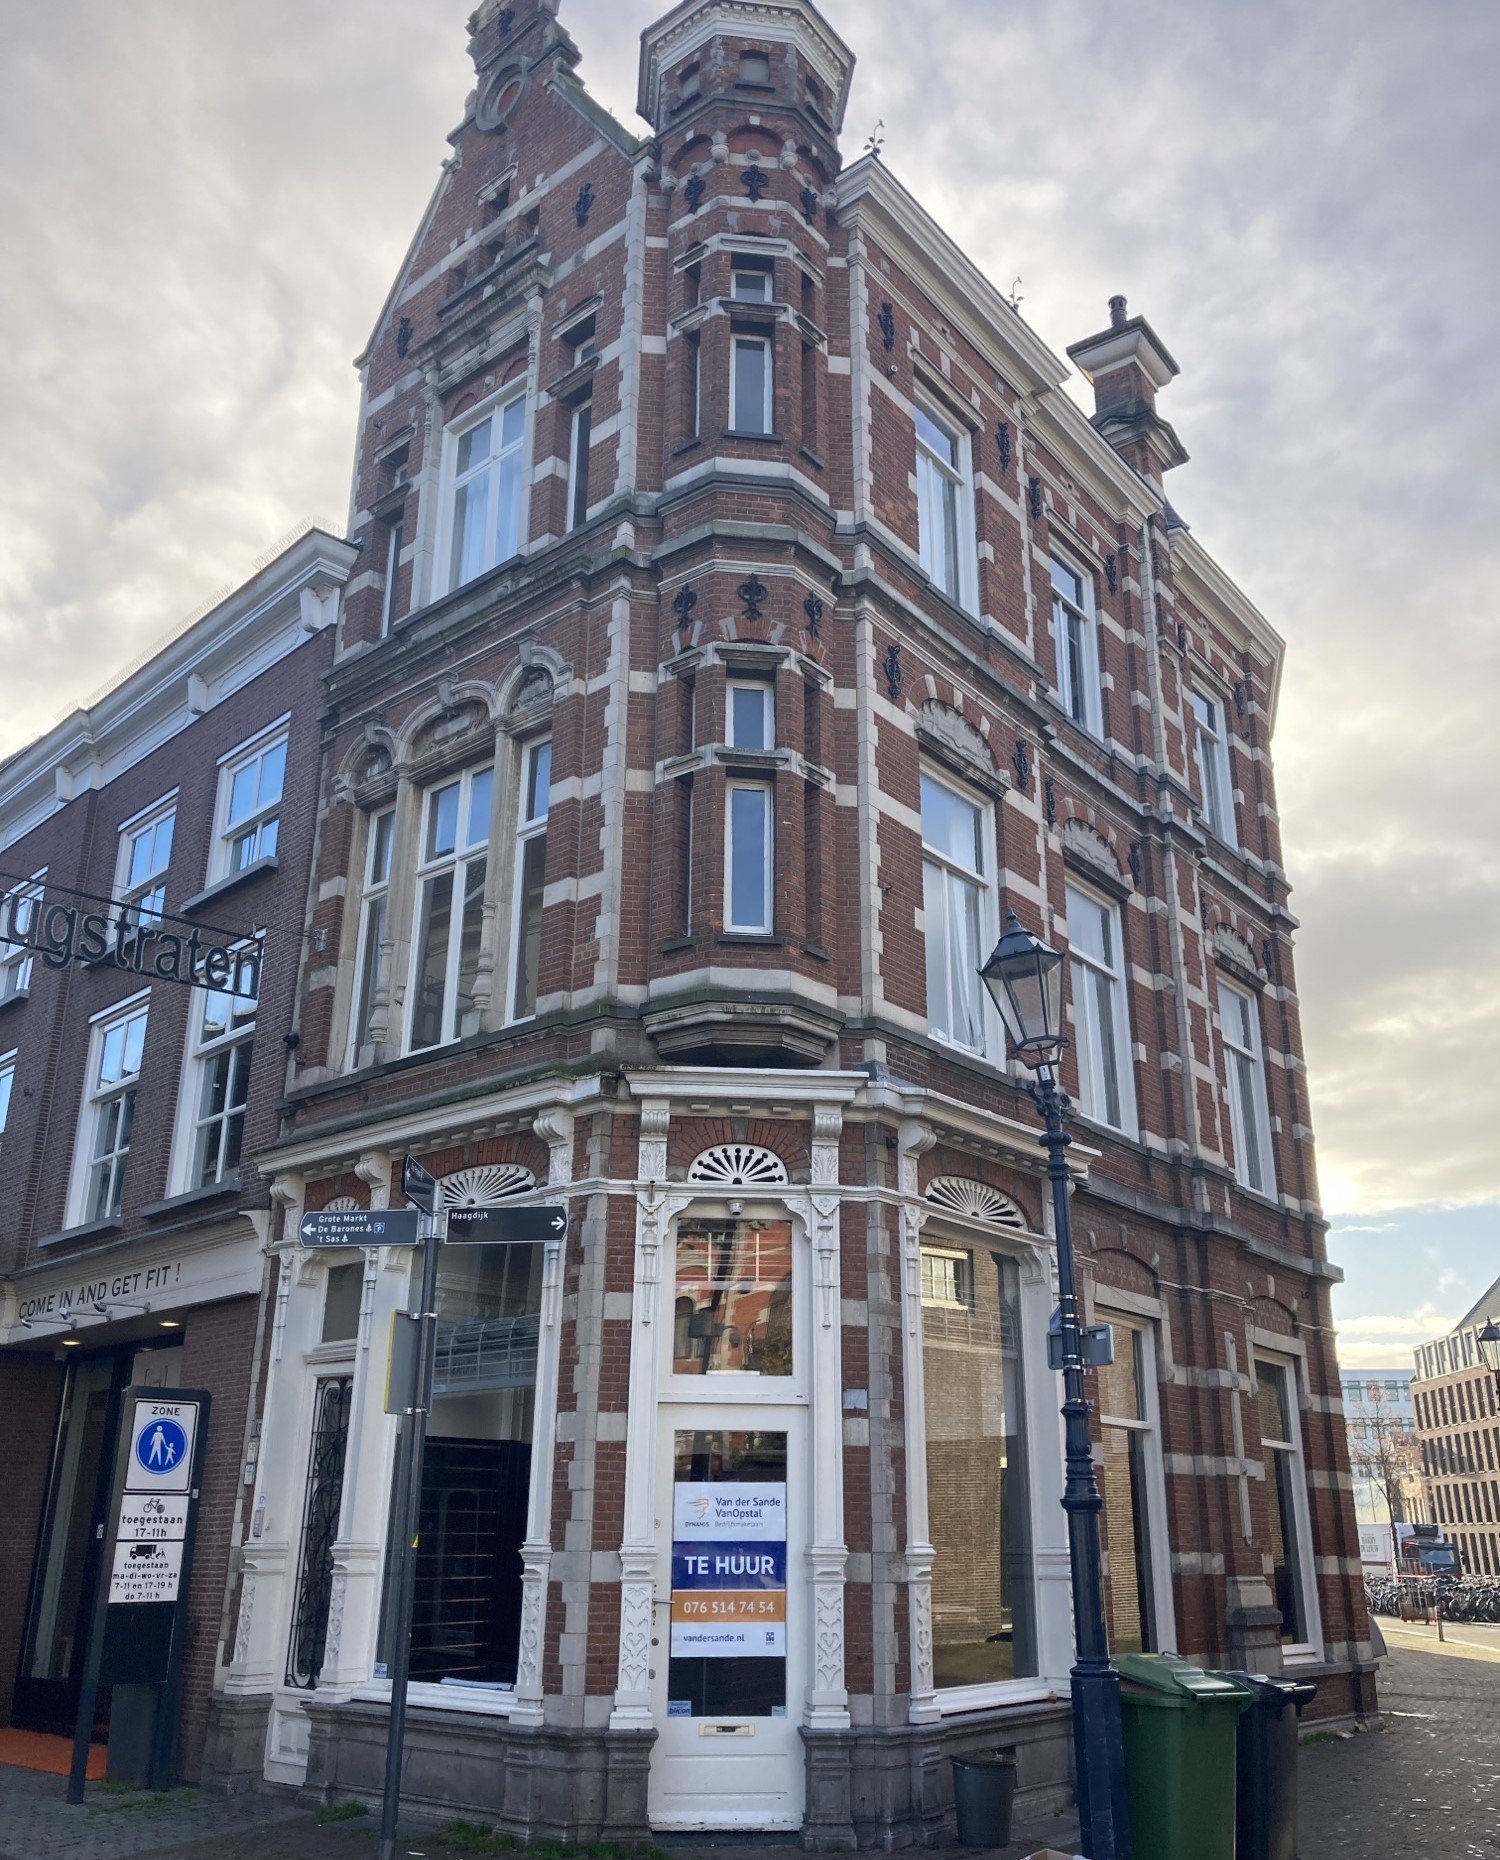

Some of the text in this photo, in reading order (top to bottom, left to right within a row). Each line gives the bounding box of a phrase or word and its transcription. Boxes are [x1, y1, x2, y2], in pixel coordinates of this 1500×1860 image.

[0, 888, 263, 999] ugstraten
[319, 1214, 367, 1223] Grote Markt
[451, 1211, 489, 1221] Haagdijk
[19, 1295, 55, 1319] COME
[59, 1290, 73, 1308] IN
[76, 1282, 107, 1305] AND
[111, 1273, 141, 1297] GET
[145, 1265, 171, 1289] FIT
[152, 1406, 181, 1416] ZONE
[715, 1497, 781, 1507] Van der Sande
[715, 1508, 762, 1519] VanOpstal
[122, 1515, 183, 1526] toegestaan
[135, 1528, 167, 1537] 17-11h
[124, 1562, 169, 1570] toegestaan
[684, 1556, 775, 1575] TE HUUR
[113, 1572, 178, 1580] ma-di-wo-vr-za
[115, 1582, 130, 1590] 7-11
[145, 1581, 166, 1589] 17-19
[125, 1592, 135, 1600] do
[137, 1592, 153, 1600] 7-11
[683, 1601, 775, 1614] 076 514 74 54
[683, 1633, 745, 1643] vandersande.nl
